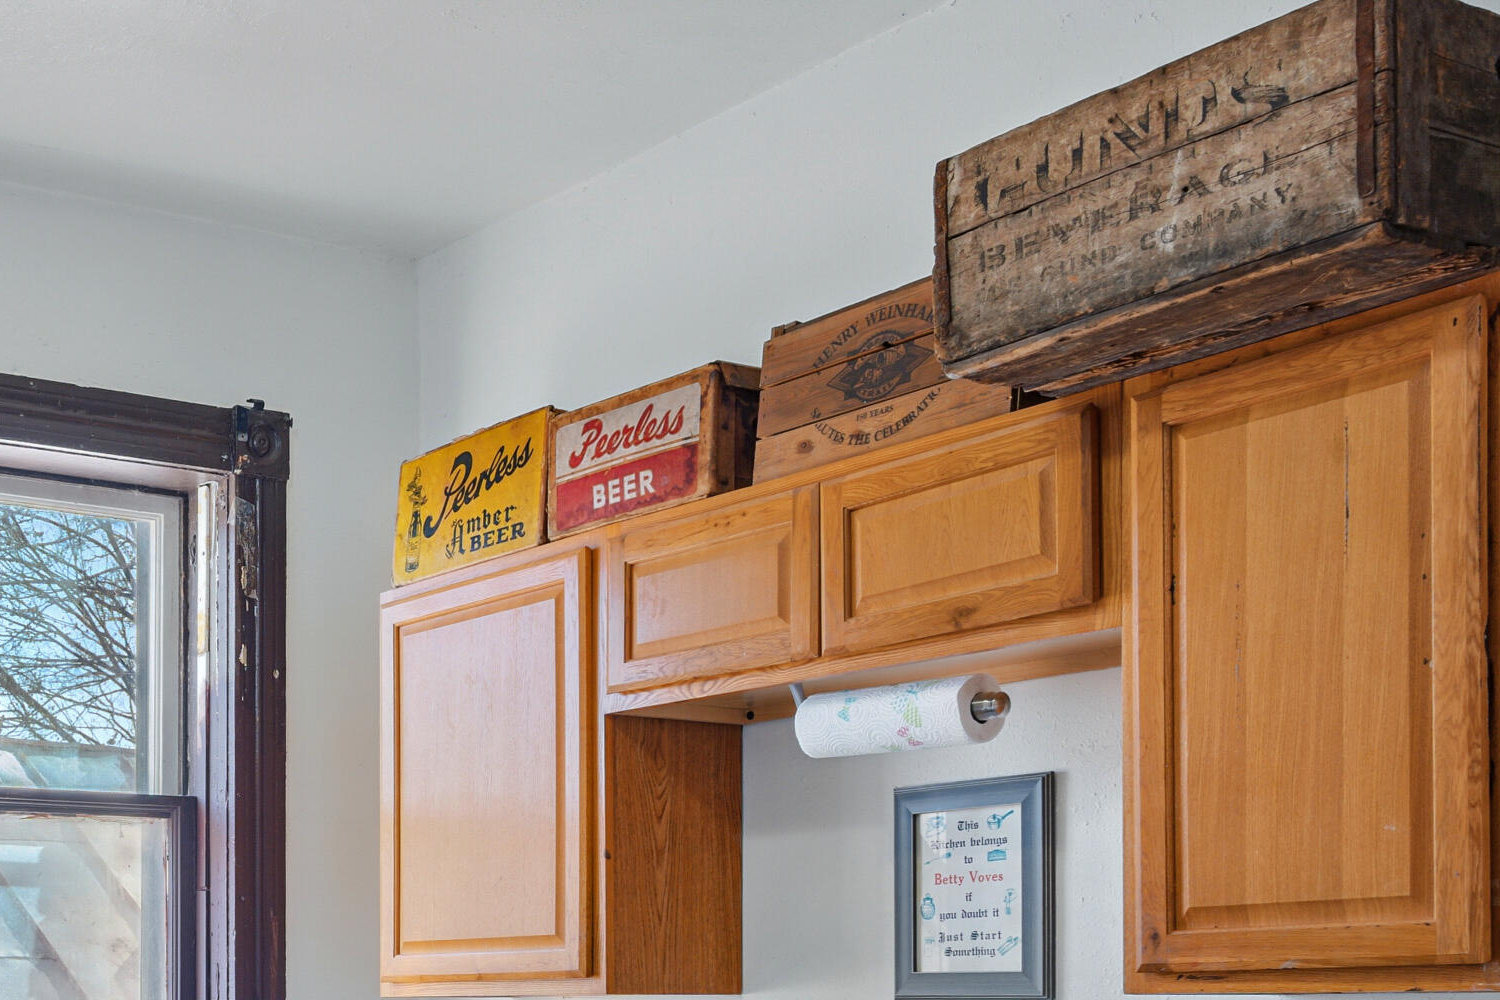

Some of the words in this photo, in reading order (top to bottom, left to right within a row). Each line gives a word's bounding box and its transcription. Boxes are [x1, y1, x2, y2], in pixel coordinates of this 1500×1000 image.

[812, 320, 859, 375] HENRY
[569, 403, 685, 469] Peerless
[848, 433, 871, 446] THE
[423, 437, 534, 538] Peerless
[593, 470, 655, 510] BEER
[445, 505, 517, 560] Amber
[470, 522, 526, 553] BEER
[957, 820, 979, 832] This
[970, 836, 1008, 848] belongs
[964, 856, 973, 864] to
[934, 872, 964, 886] Betty
[969, 871, 1004, 884] Voves
[966, 892, 973, 902] if
[939, 910, 957, 922] you
[961, 908, 988, 919] doubt
[993, 908, 999, 917] it
[938, 931, 964, 943] Just
[970, 931, 1003, 941] Start
[944, 946, 996, 957] Something
